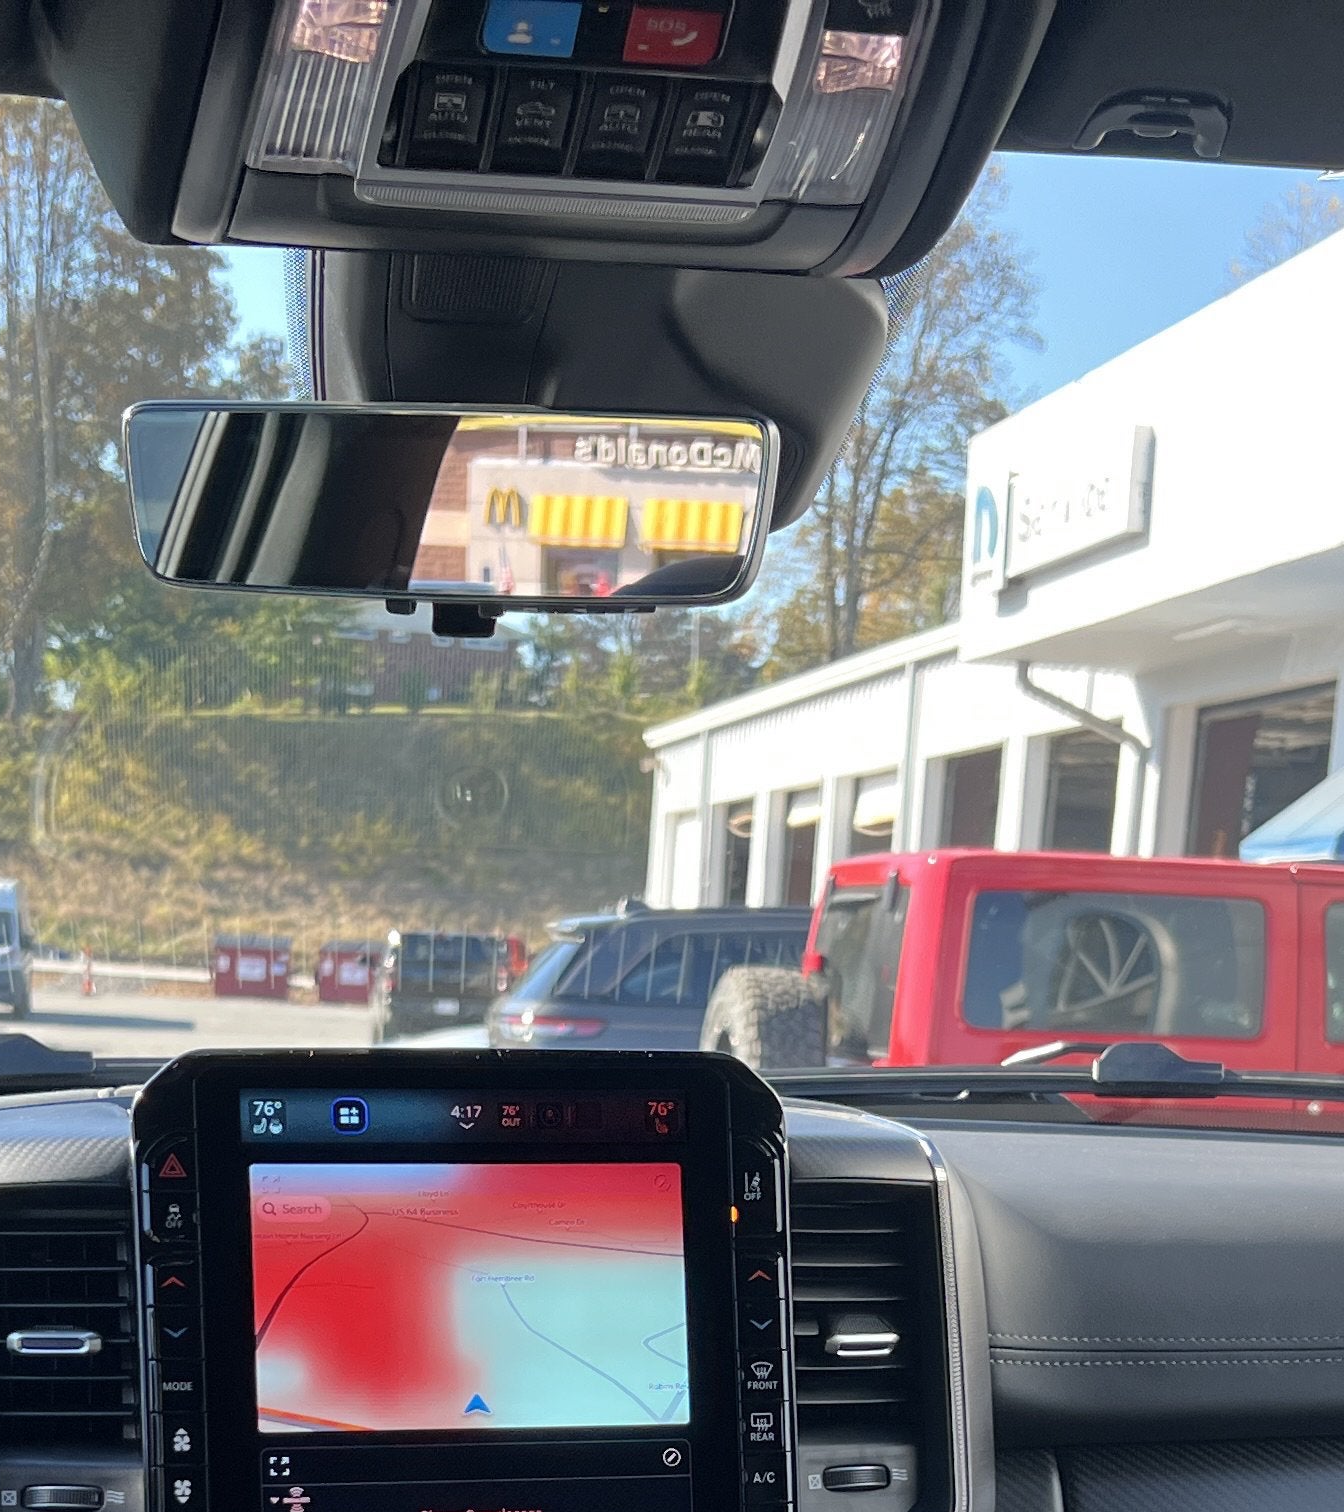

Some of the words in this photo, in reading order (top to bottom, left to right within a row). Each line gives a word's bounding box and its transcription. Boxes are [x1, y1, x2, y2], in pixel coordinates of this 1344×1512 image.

[450, 1105, 482, 1118] 4:17
[281, 1204, 323, 1216] Search
[163, 1381, 194, 1391] MODE
[747, 1381, 778, 1390] FRONT
[750, 1432, 775, 1441] REAR
[753, 1472, 776, 1483] A/C
